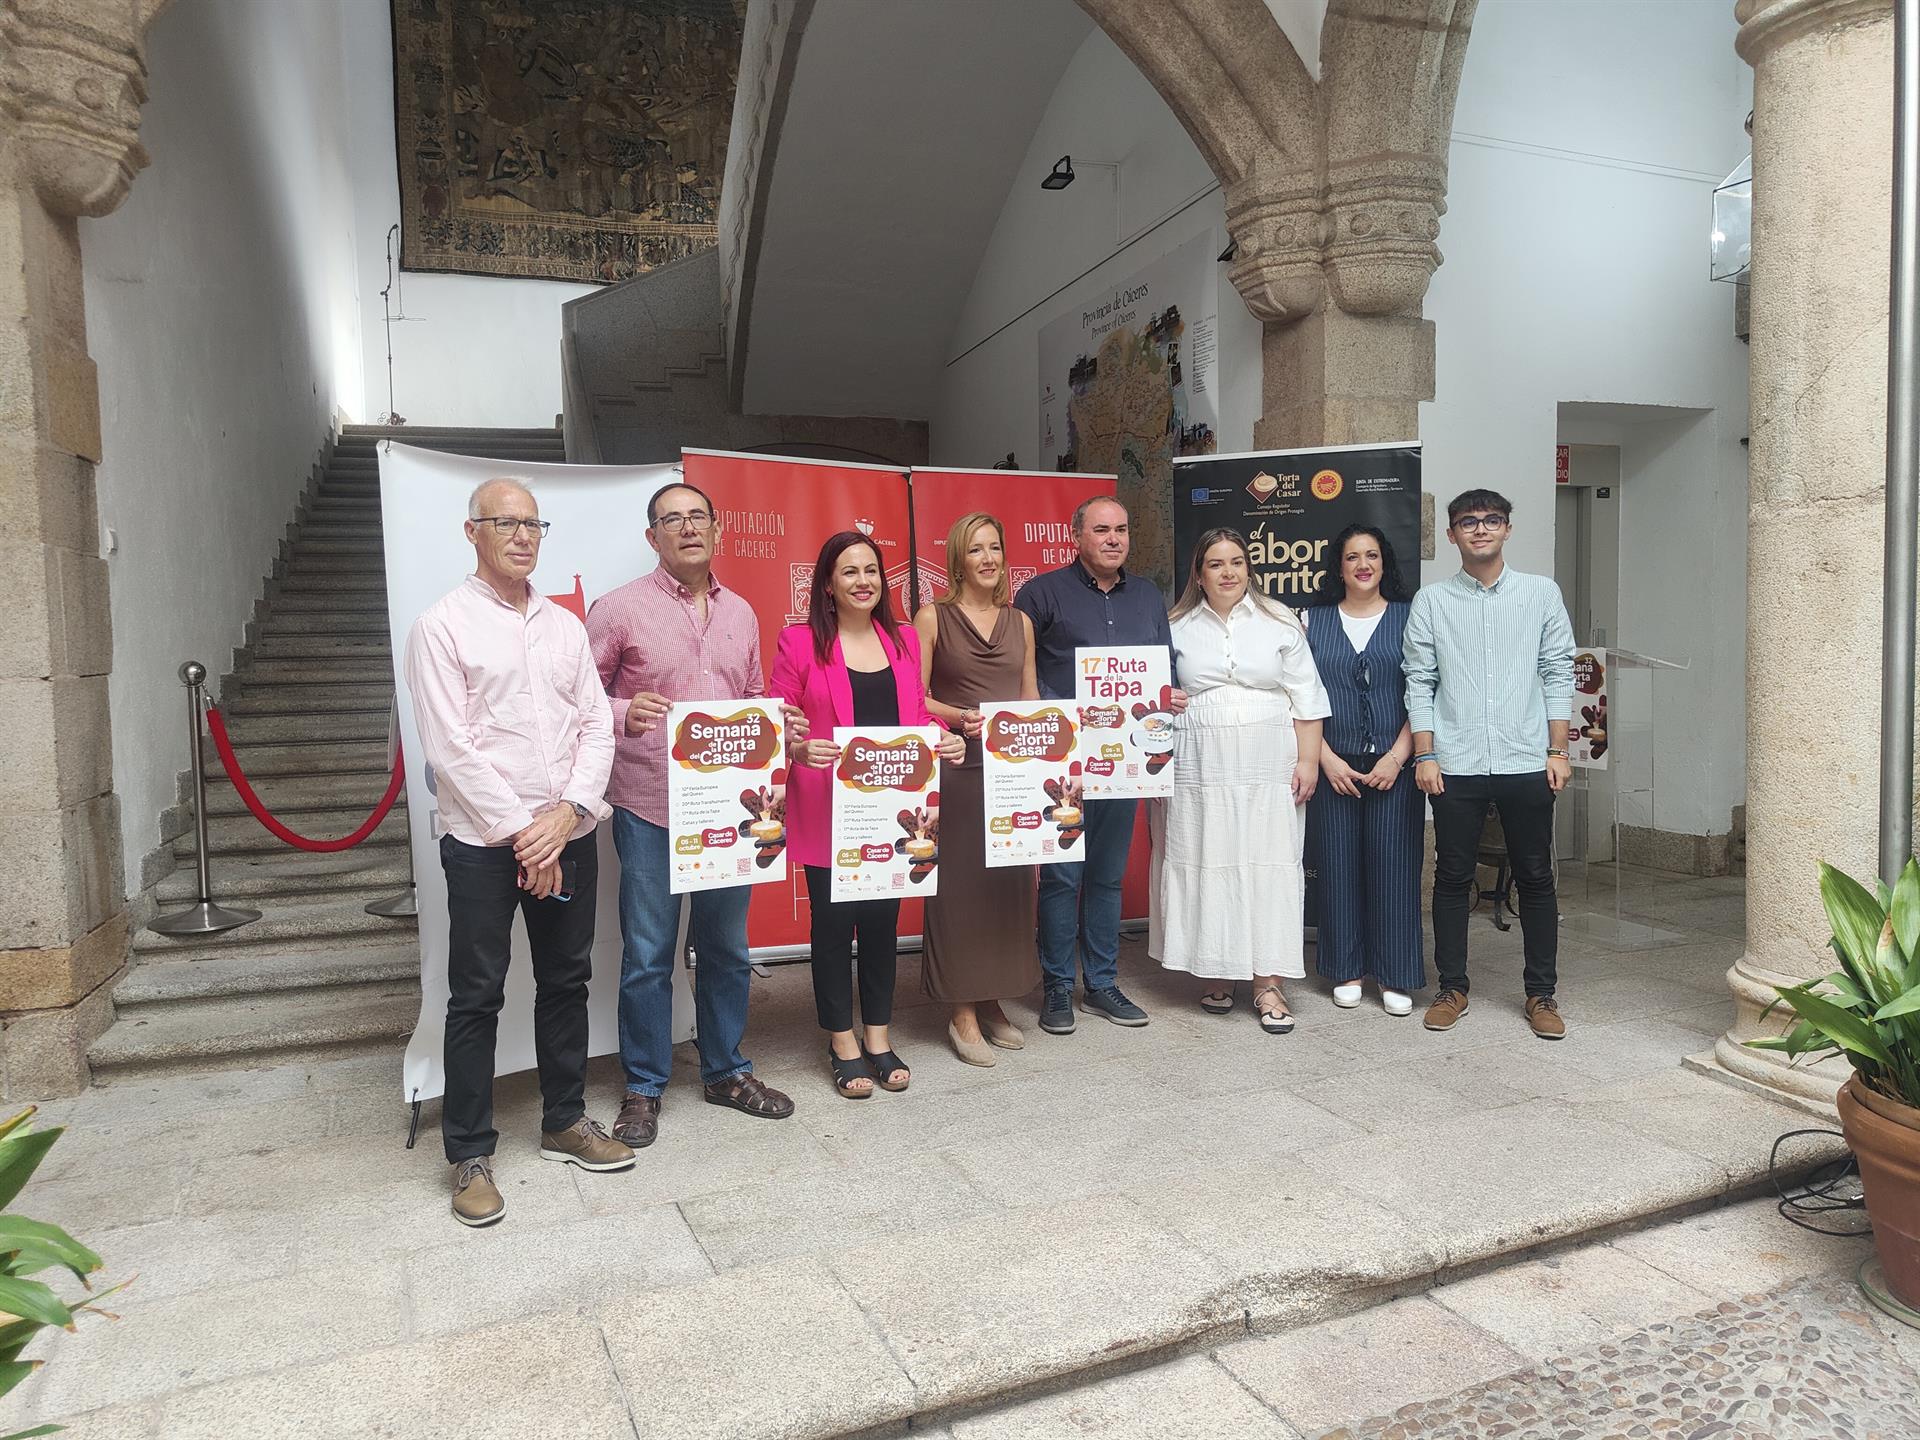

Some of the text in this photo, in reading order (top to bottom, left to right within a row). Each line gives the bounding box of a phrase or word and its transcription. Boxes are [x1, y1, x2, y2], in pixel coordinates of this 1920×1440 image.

[1083, 283, 1148, 329] Provincia de Cáceres
[1024, 523, 1074, 543] DIPUTA
[1250, 522, 1266, 539] el
[714, 538, 776, 559] DE CÁCERES
[1043, 546, 1079, 564] DE CÁC
[1108, 657, 1147, 673] Ruta
[1574, 664, 1593, 672] ana
[1085, 676, 1142, 702] Tapa
[747, 713, 760, 723] 32
[1046, 713, 1058, 721] 32
[690, 723, 761, 739] Semana
[999, 721, 1059, 735] Semana
[715, 738, 756, 752] Torta
[906, 740, 918, 749] 32
[1020, 734, 1055, 746] Torta
[855, 747, 919, 761] Semana
[1008, 744, 1048, 756] Casar
[700, 751, 746, 765] Casar
[876, 762, 914, 774] Torta
[862, 773, 905, 786] Casar
